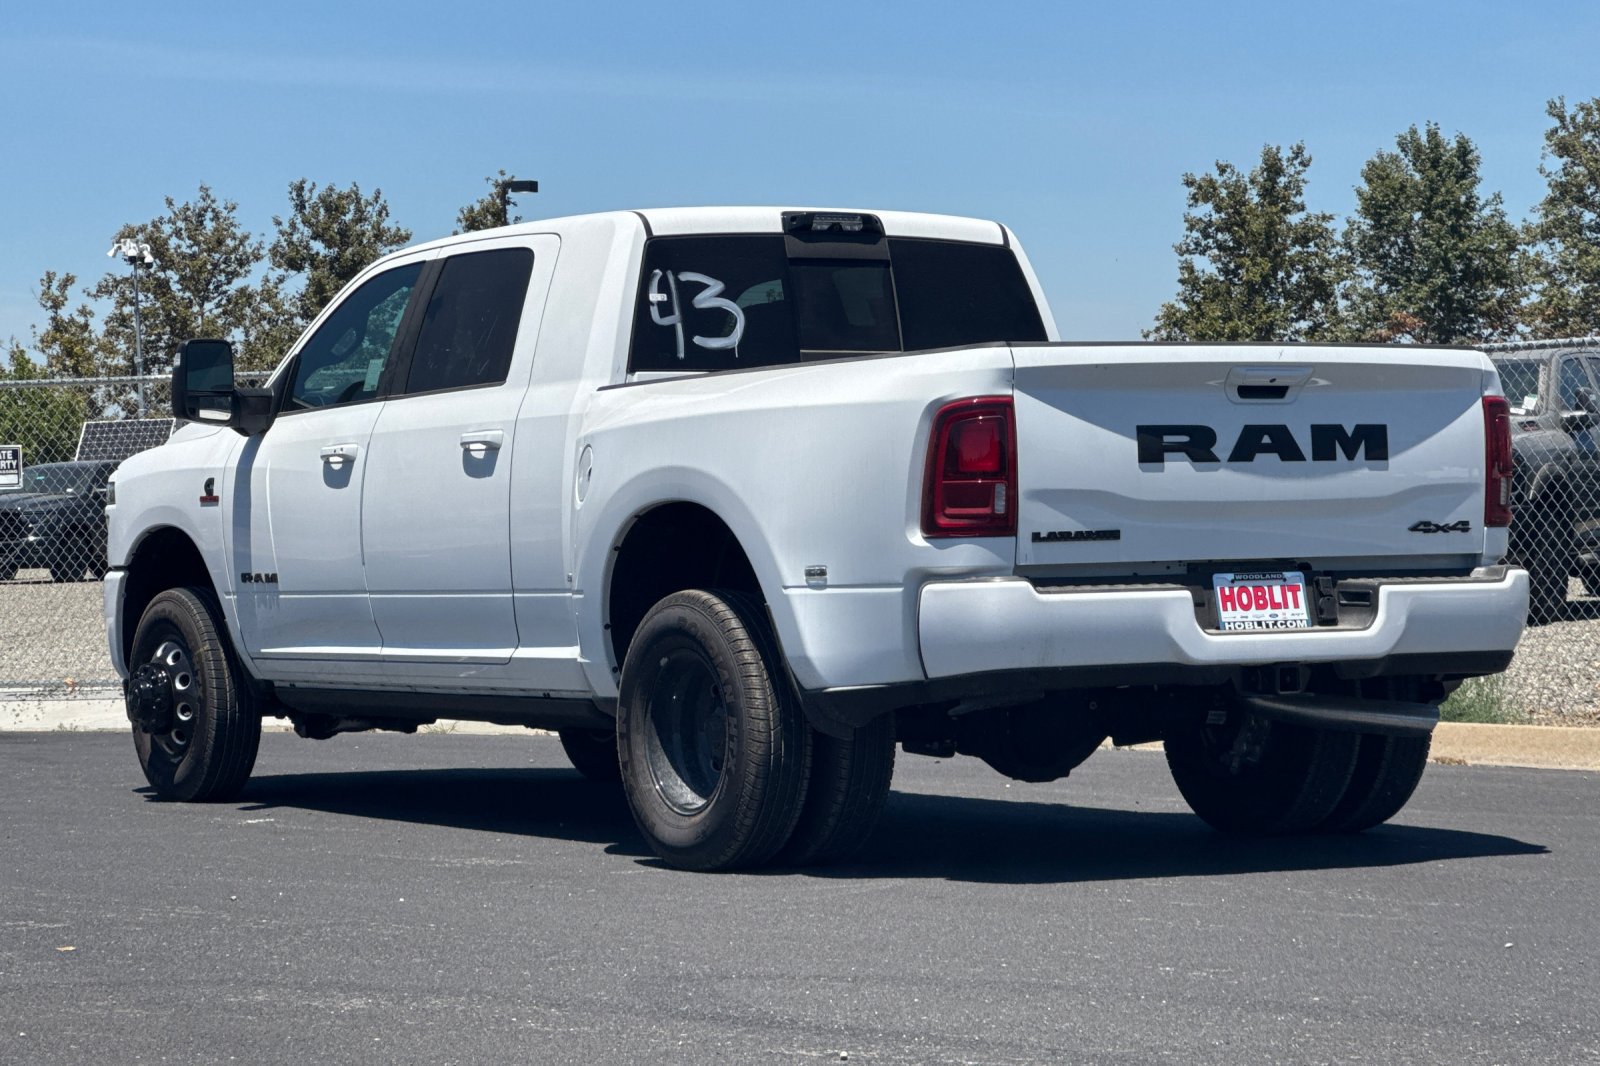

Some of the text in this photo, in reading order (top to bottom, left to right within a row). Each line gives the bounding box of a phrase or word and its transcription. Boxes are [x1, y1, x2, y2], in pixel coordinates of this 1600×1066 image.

[648, 269, 746, 360] 43
[1136, 424, 1389, 463] RAM
[1407, 520, 1472, 533] 4x4
[1031, 530, 1121, 543] LARAMIE
[241, 572, 279, 584] RAM
[1219, 584, 1301, 612] HOBLIT
[1225, 620, 1308, 631] HOBLIT.COM
